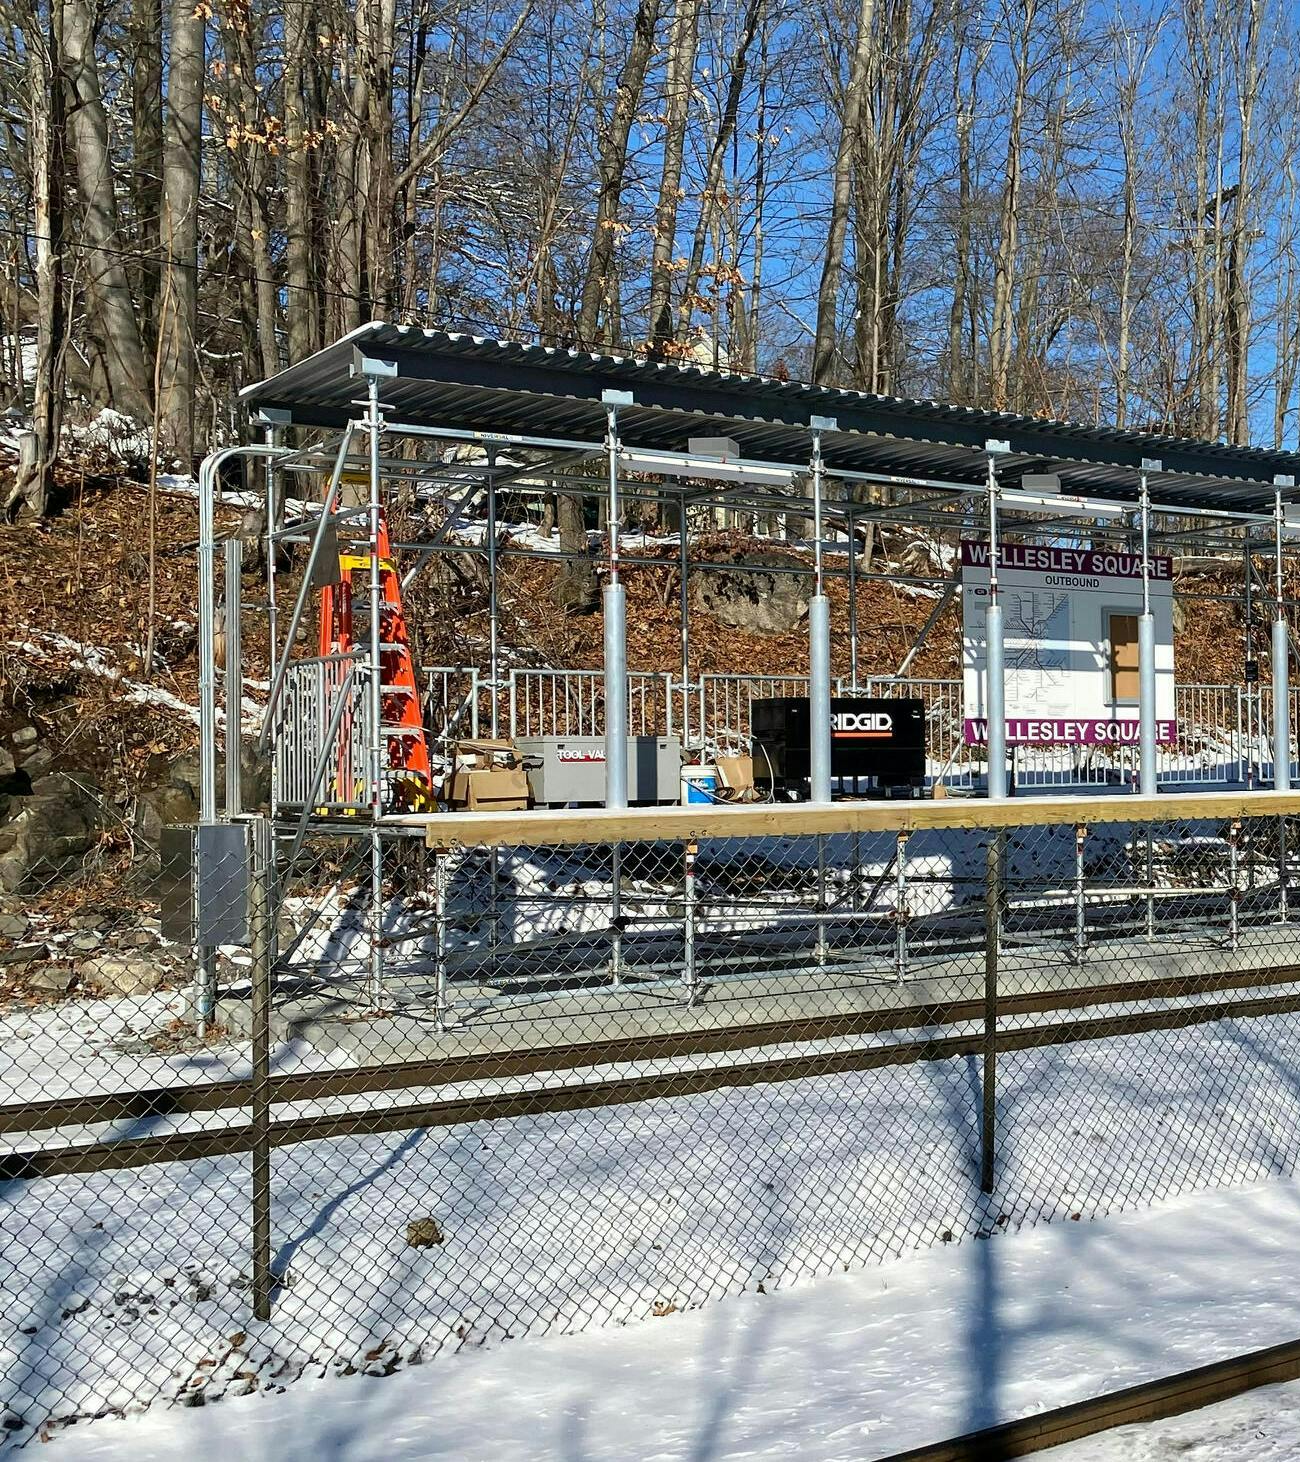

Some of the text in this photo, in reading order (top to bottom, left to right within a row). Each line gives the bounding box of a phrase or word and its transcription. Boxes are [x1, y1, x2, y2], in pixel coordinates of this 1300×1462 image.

[1092, 554, 1168, 577] SQUARE
[1045, 575, 1100, 588] OUTBOUND
[971, 721, 1170, 741] WLLESLEY SQUE
